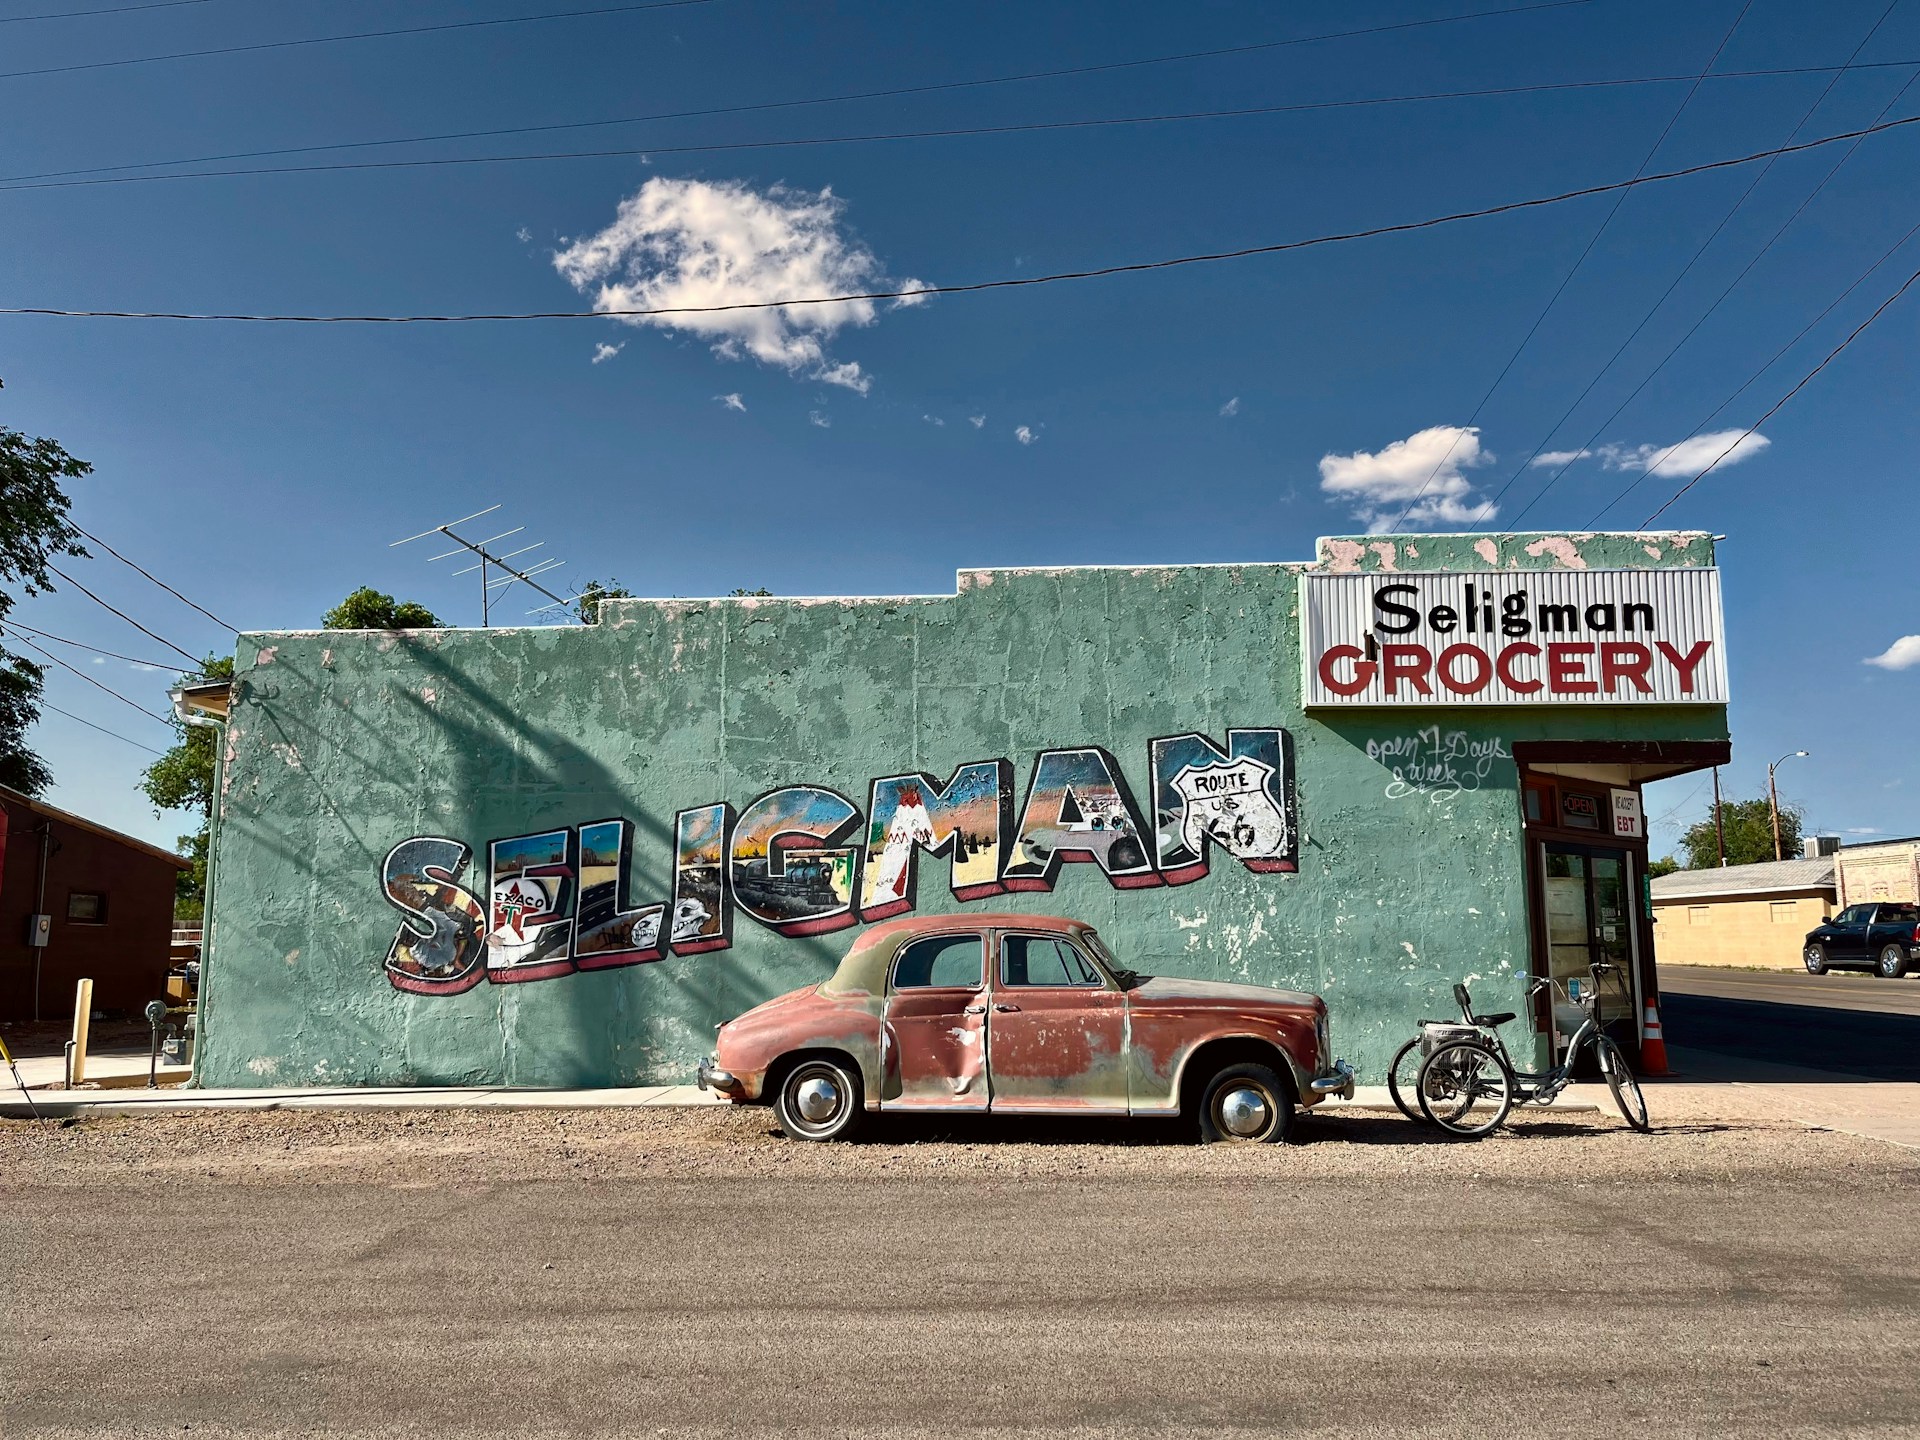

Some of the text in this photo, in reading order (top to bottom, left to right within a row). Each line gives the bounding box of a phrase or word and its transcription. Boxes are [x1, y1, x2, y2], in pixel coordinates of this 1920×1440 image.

[1374, 583, 1655, 637] Seligman
[1319, 641, 1712, 696] GROCERY
[1444, 731, 1514, 777] Days
[1194, 773, 1249, 793] ROUTE
[1211, 798, 1240, 811] US
[1567, 797, 1594, 813] OPEN
[1616, 815, 1635, 833] EBT
[382, 728, 1299, 993] SELIGMAN
